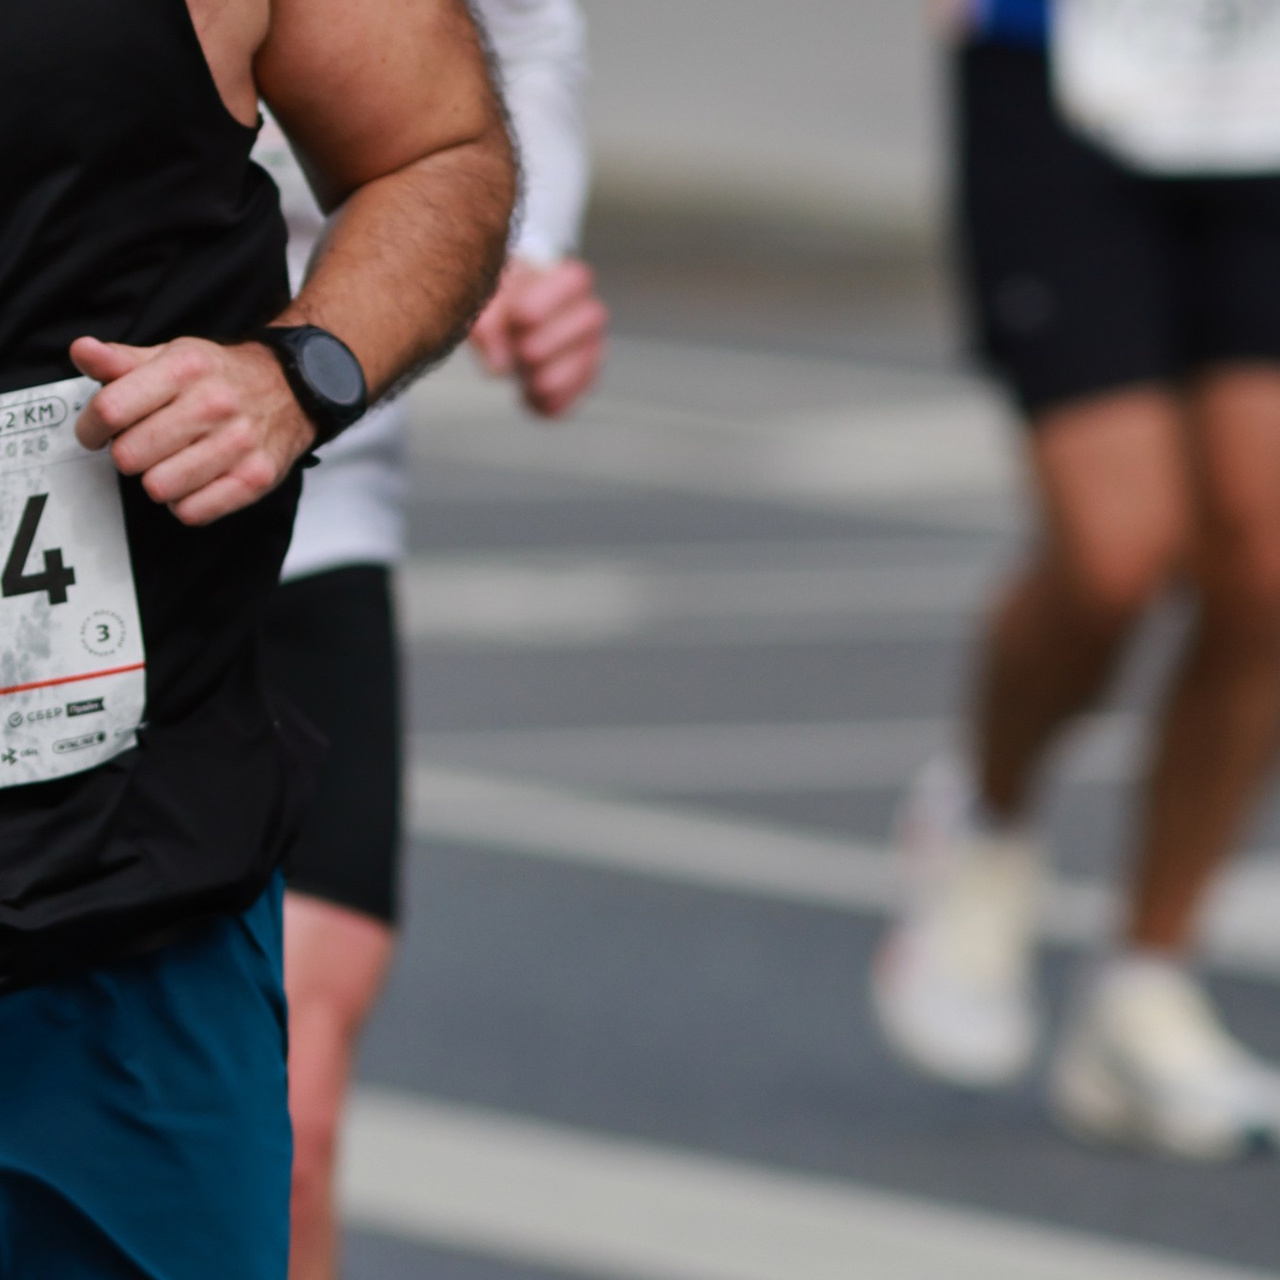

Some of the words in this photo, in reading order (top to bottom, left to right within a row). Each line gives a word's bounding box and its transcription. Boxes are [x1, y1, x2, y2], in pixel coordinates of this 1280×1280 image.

[24, 403, 54, 424] КМ
[95, 624, 110, 642] 3
[26, 707, 63, 722] СБЕР
